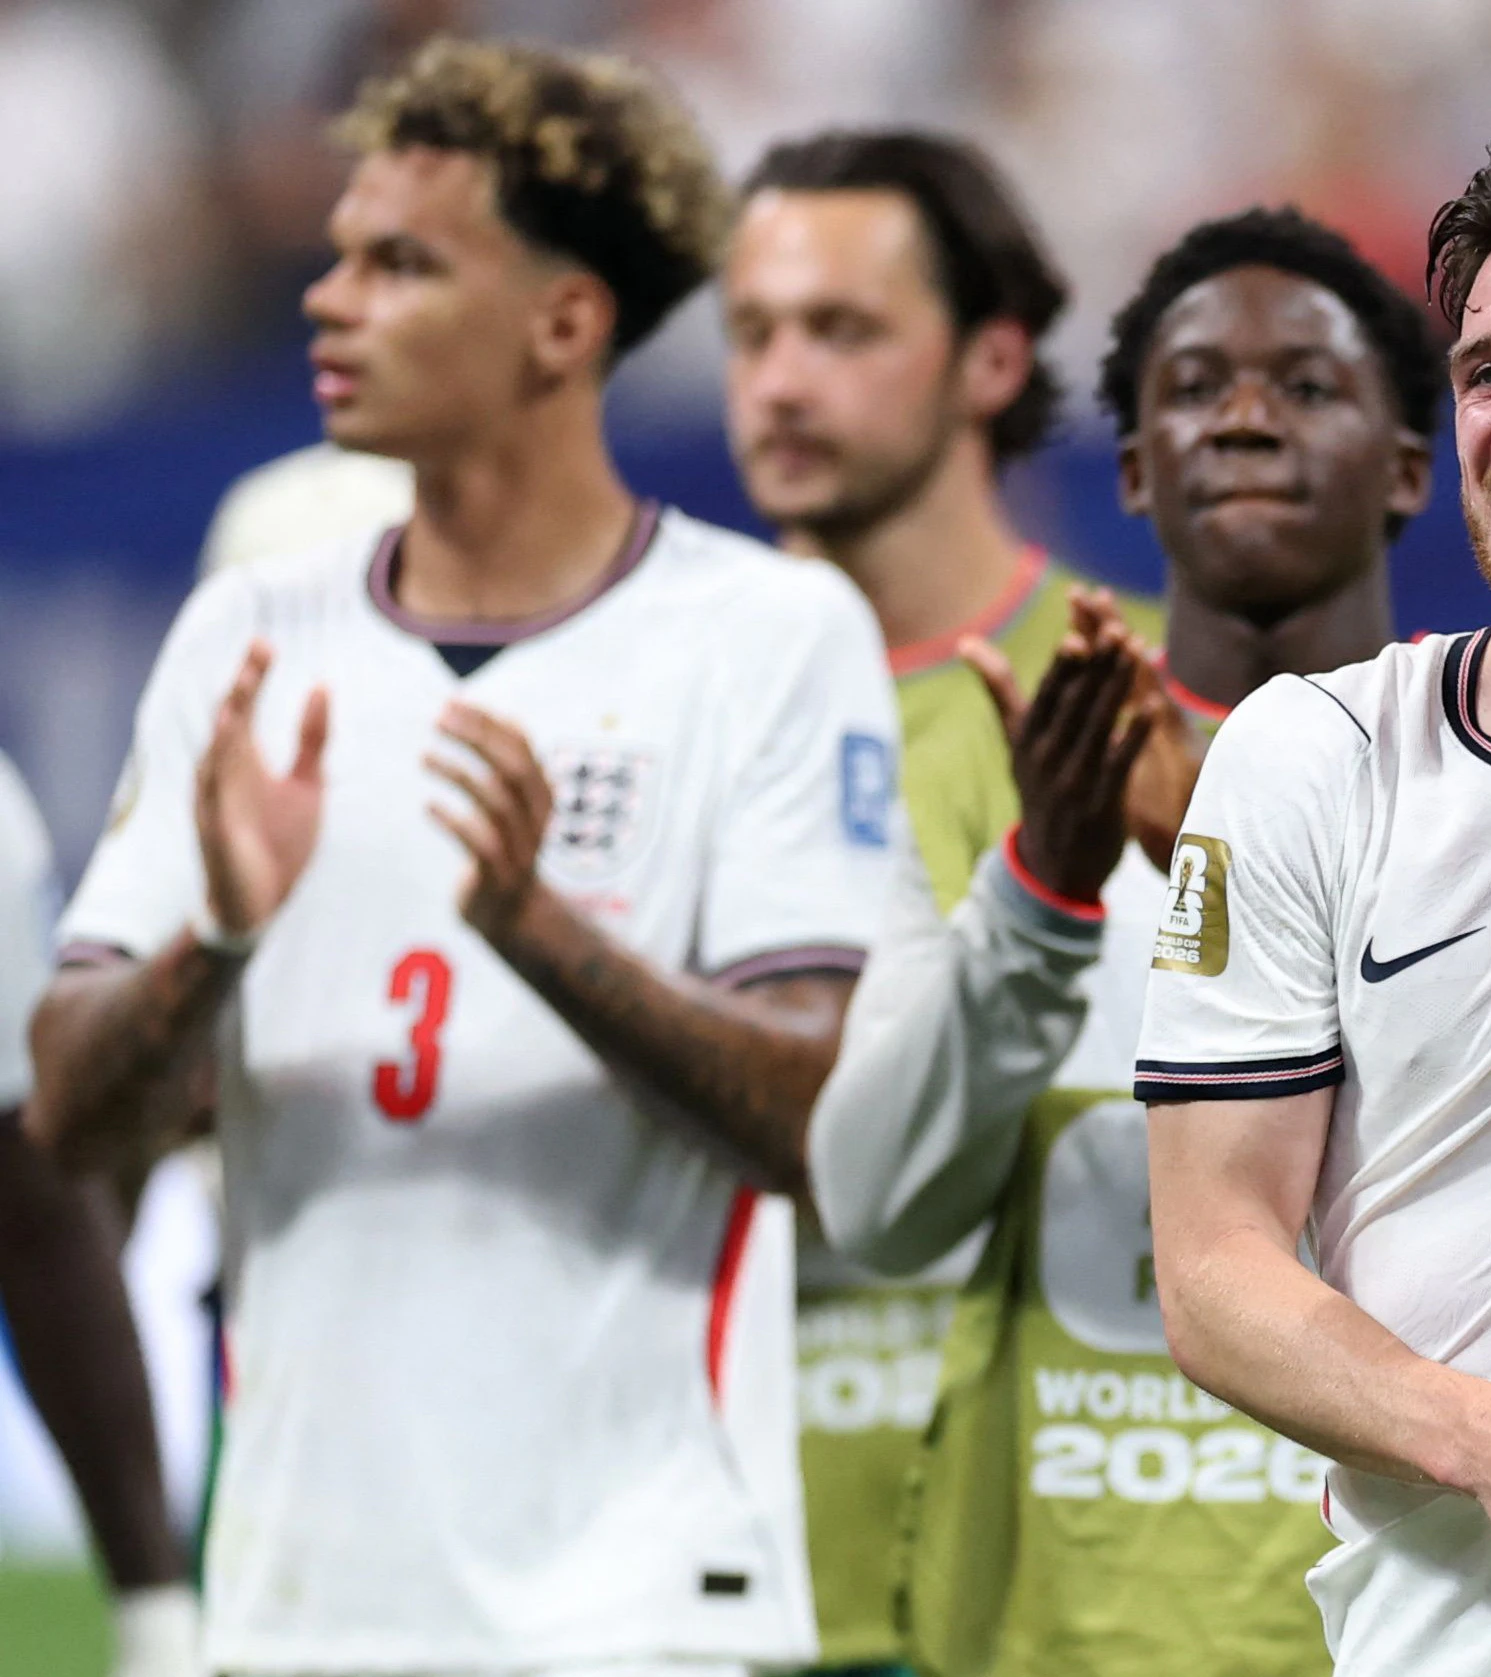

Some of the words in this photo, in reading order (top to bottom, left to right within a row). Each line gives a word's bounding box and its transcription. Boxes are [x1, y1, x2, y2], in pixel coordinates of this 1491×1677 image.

[1169, 914, 1189, 927] FIFA
[1183, 938, 1201, 949] CUP
[1153, 944, 1200, 963] 2026
[372, 947, 453, 1123] 3
[1031, 1423, 1329, 1502] 2026
